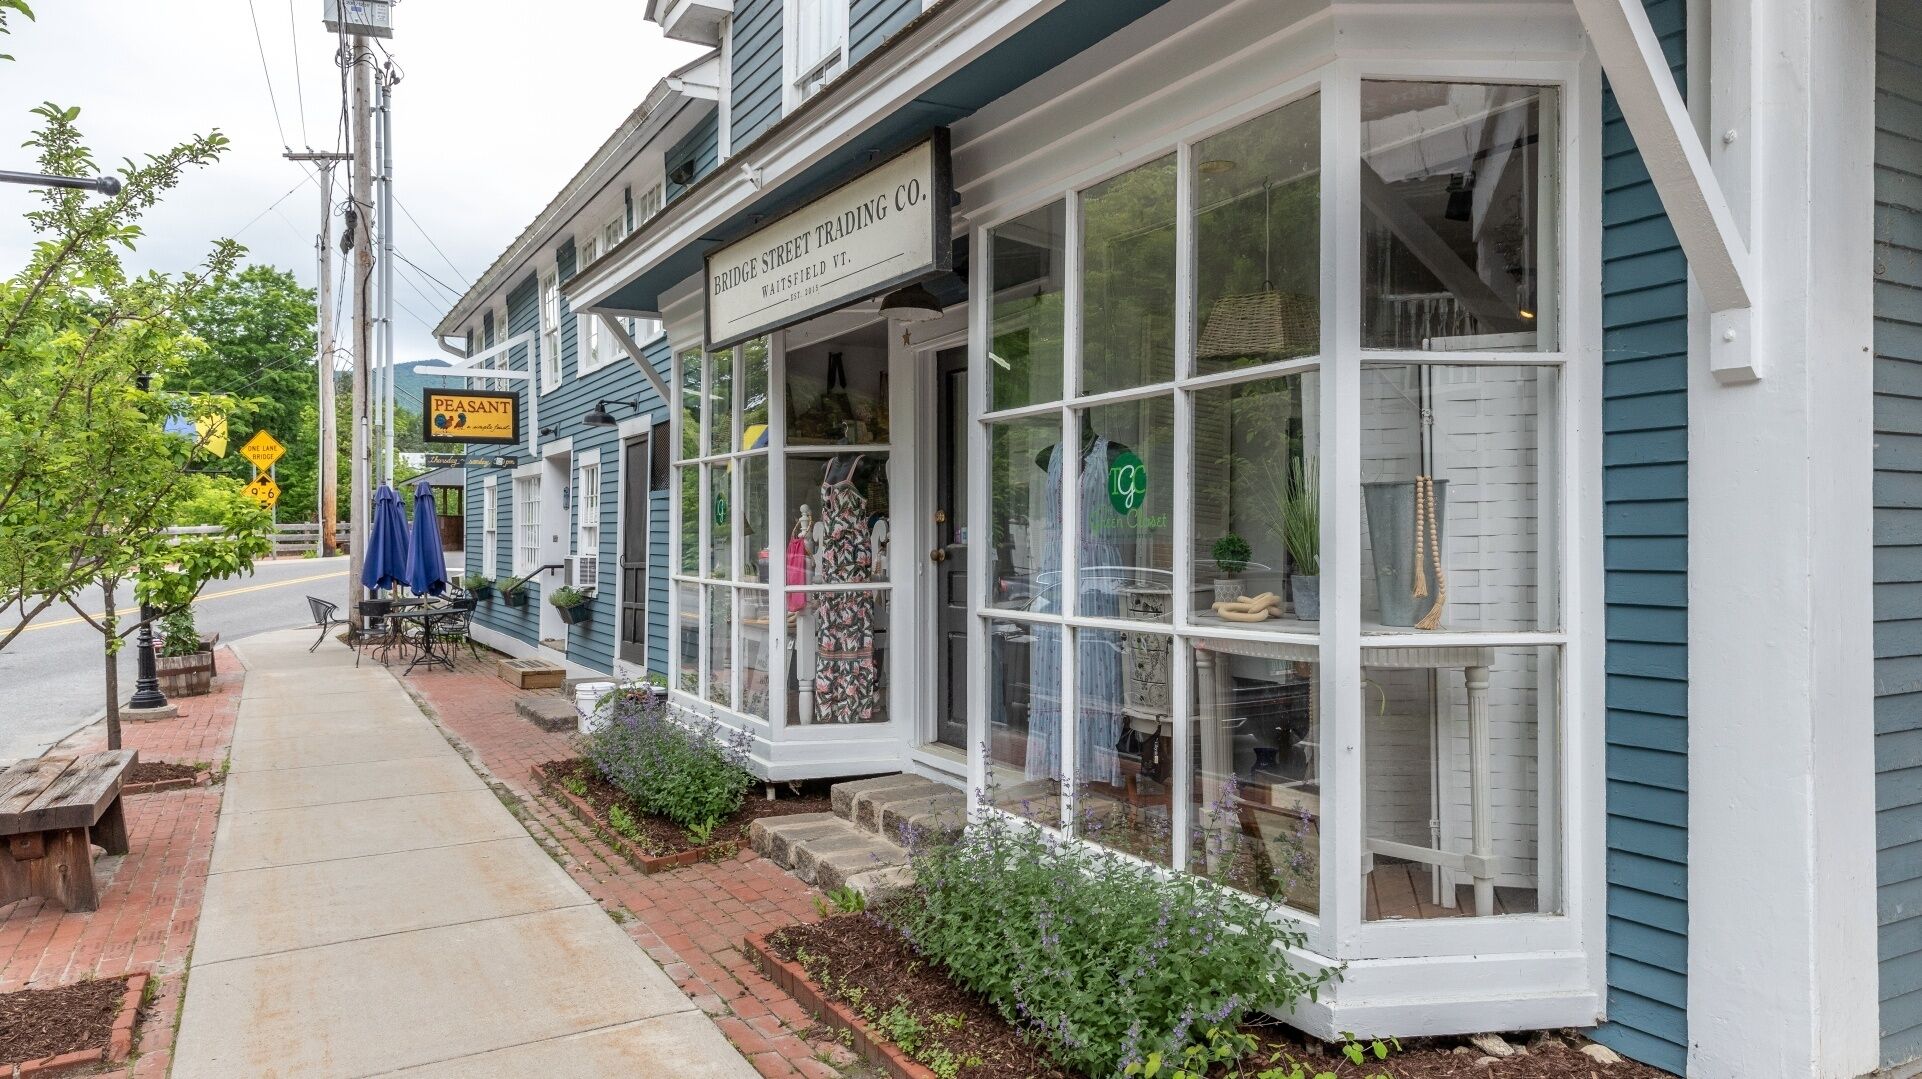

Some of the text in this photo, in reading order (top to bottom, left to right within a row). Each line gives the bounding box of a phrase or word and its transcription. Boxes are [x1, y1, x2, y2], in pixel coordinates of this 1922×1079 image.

[714, 178, 927, 296] BRIDGE STREET TRADING CO.
[761, 251, 852, 299] WAITSFIELD VT.
[805, 284, 819, 296] 2015
[434, 398, 511, 414] PEASANT
